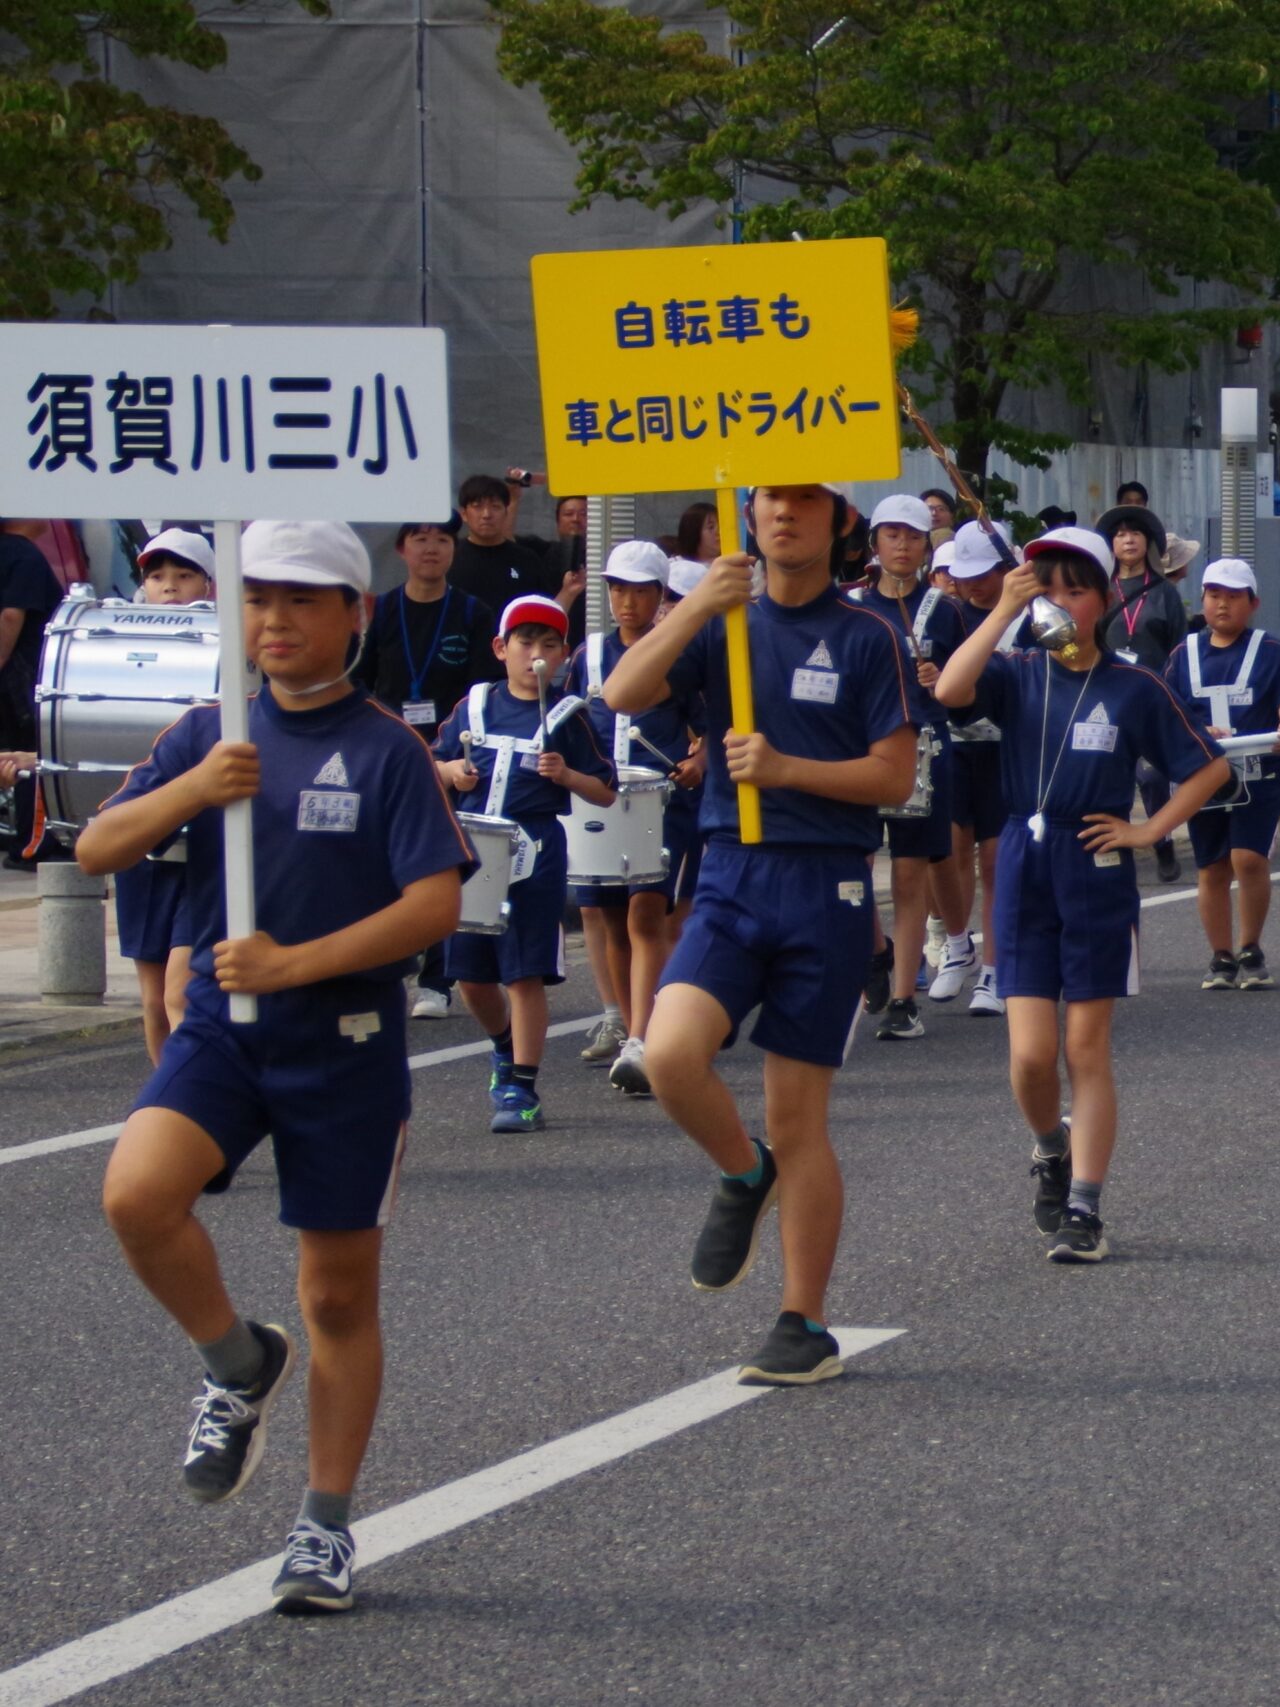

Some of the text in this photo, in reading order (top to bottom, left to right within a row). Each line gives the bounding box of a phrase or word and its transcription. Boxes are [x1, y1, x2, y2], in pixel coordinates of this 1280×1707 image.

[614, 292, 811, 349] 自転車も
[27, 371, 418, 475] 須賀川三小
[565, 384, 881, 446] 車と同じドライバー
[113, 614, 194, 626] YAMAHA
